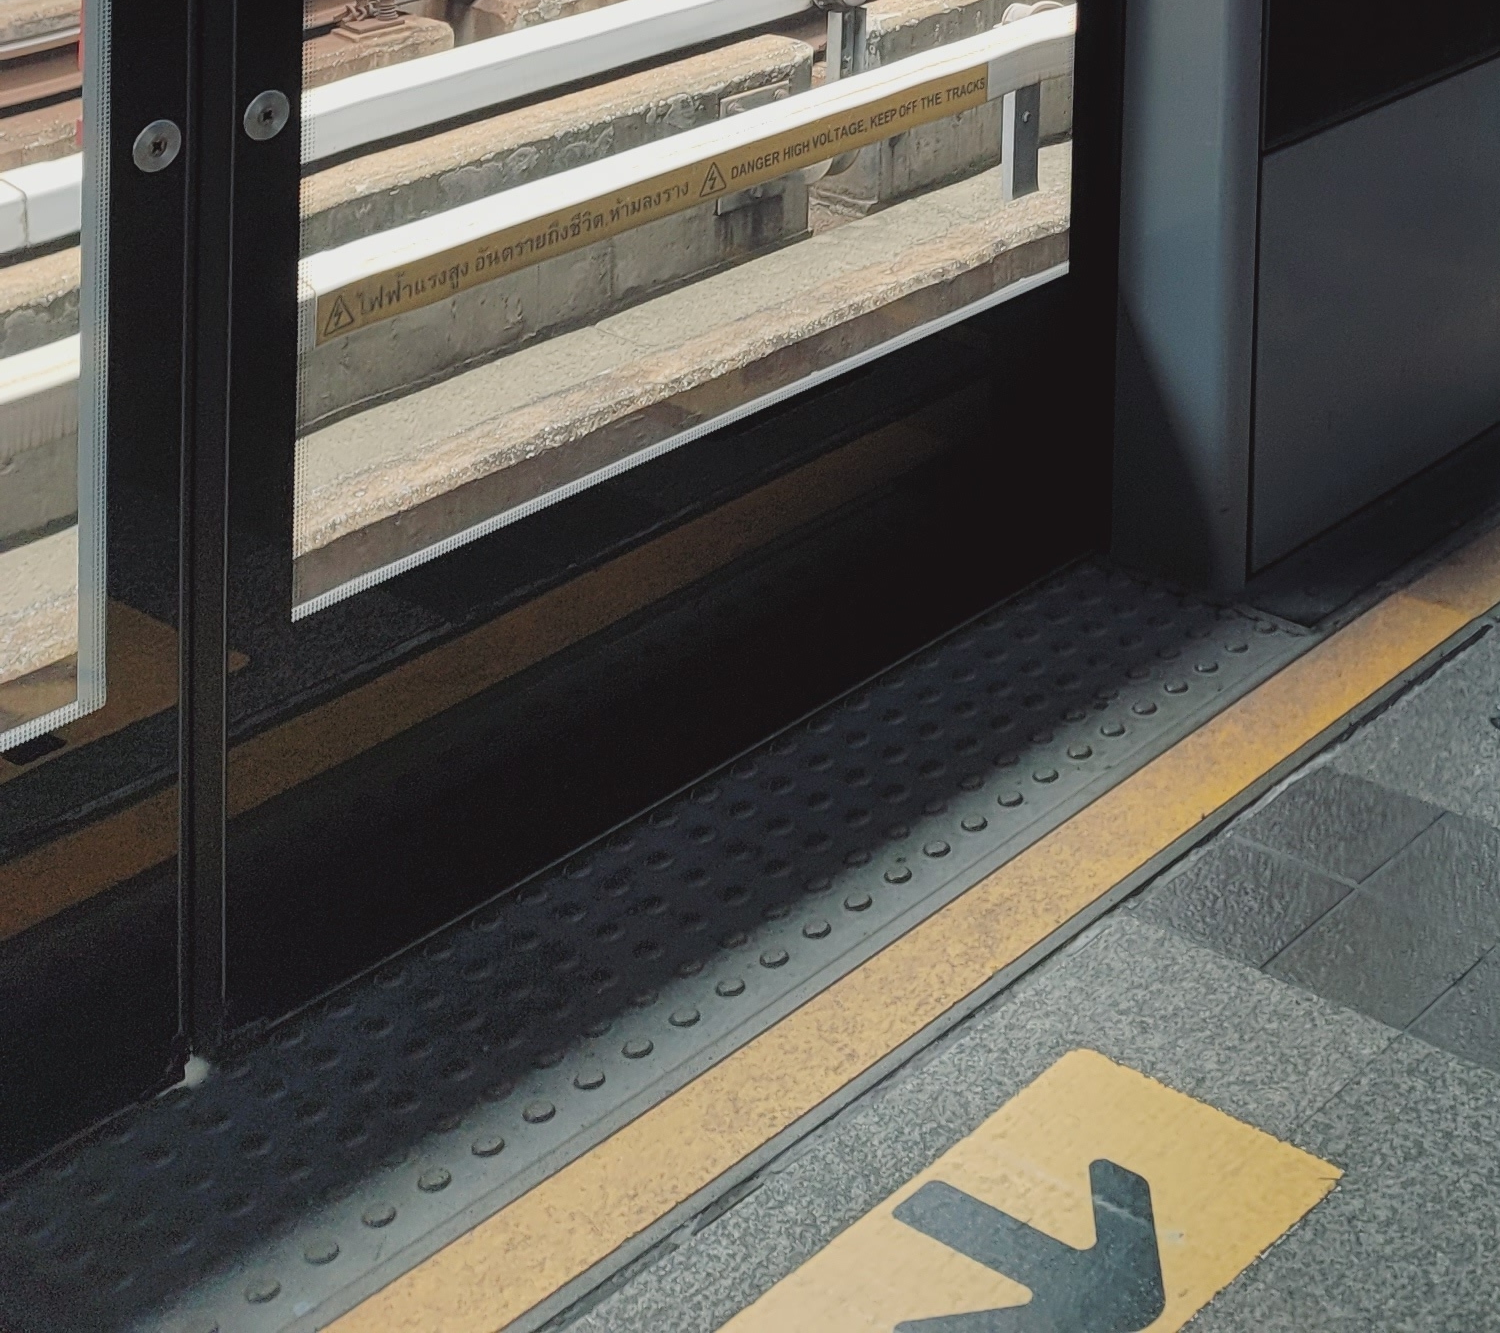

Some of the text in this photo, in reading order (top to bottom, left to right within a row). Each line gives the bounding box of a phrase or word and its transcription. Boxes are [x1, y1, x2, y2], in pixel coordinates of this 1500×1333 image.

[731, 78, 986, 180] DANGER HIGH VOLTAGE, KEEP OFF THE TRACKS
[358, 261, 470, 316] ไฟฟ้าแรงสูง
